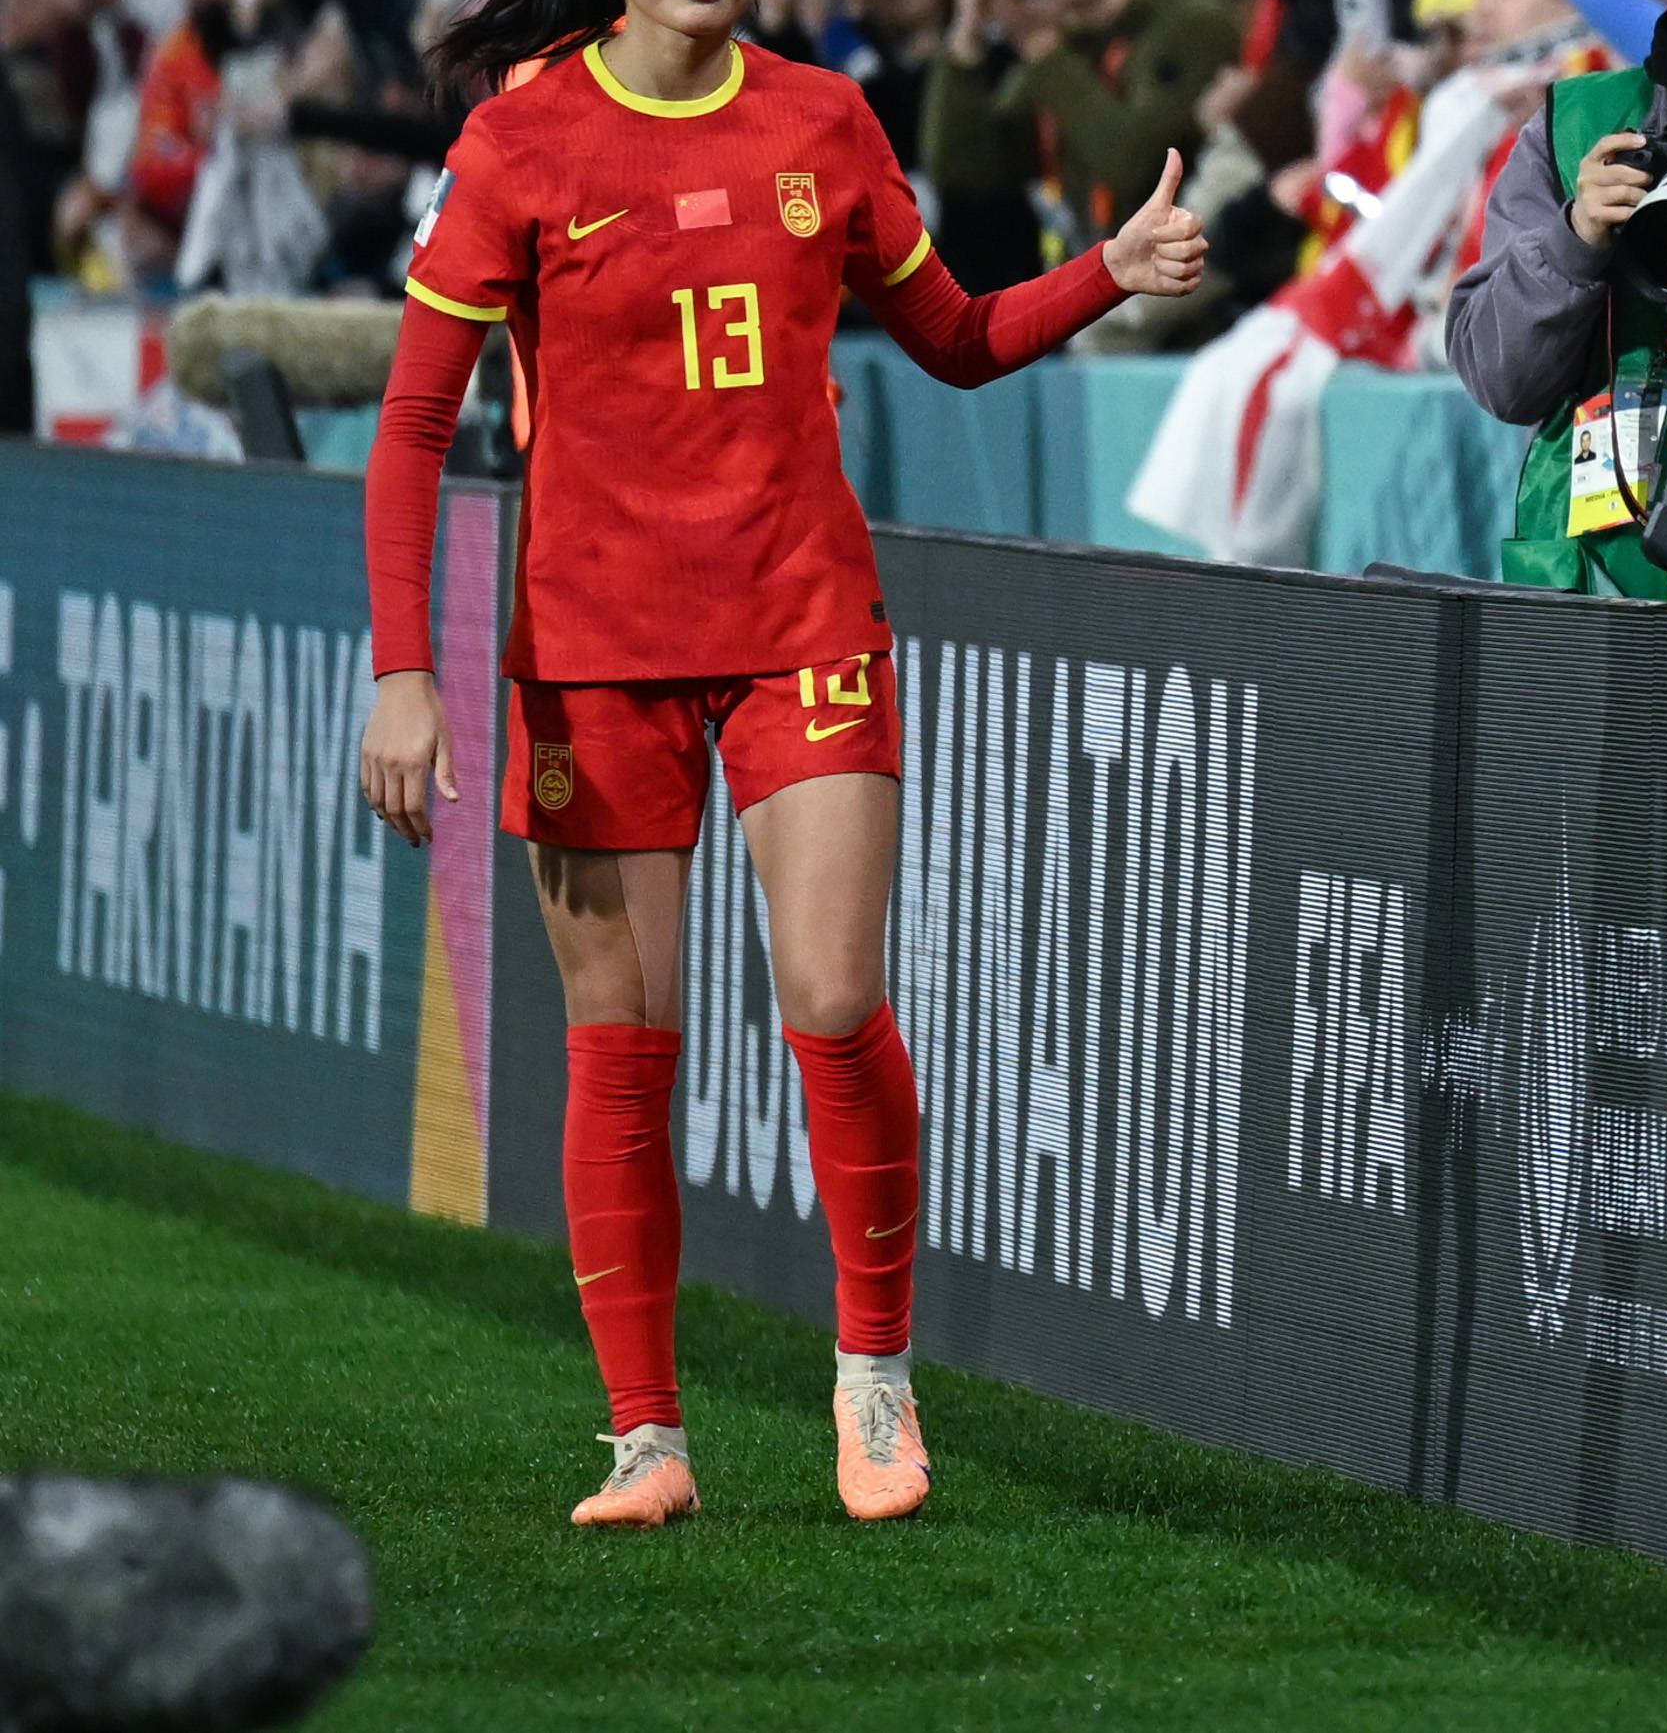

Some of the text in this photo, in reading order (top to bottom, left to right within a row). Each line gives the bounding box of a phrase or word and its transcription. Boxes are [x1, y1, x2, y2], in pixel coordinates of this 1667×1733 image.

[780, 176, 812, 191] CFA
[672, 281, 765, 391] 13
[538, 747, 569, 761] CFA
[58, 587, 384, 1055] TARNTANYA
[1287, 868, 1408, 1212] FIFA
